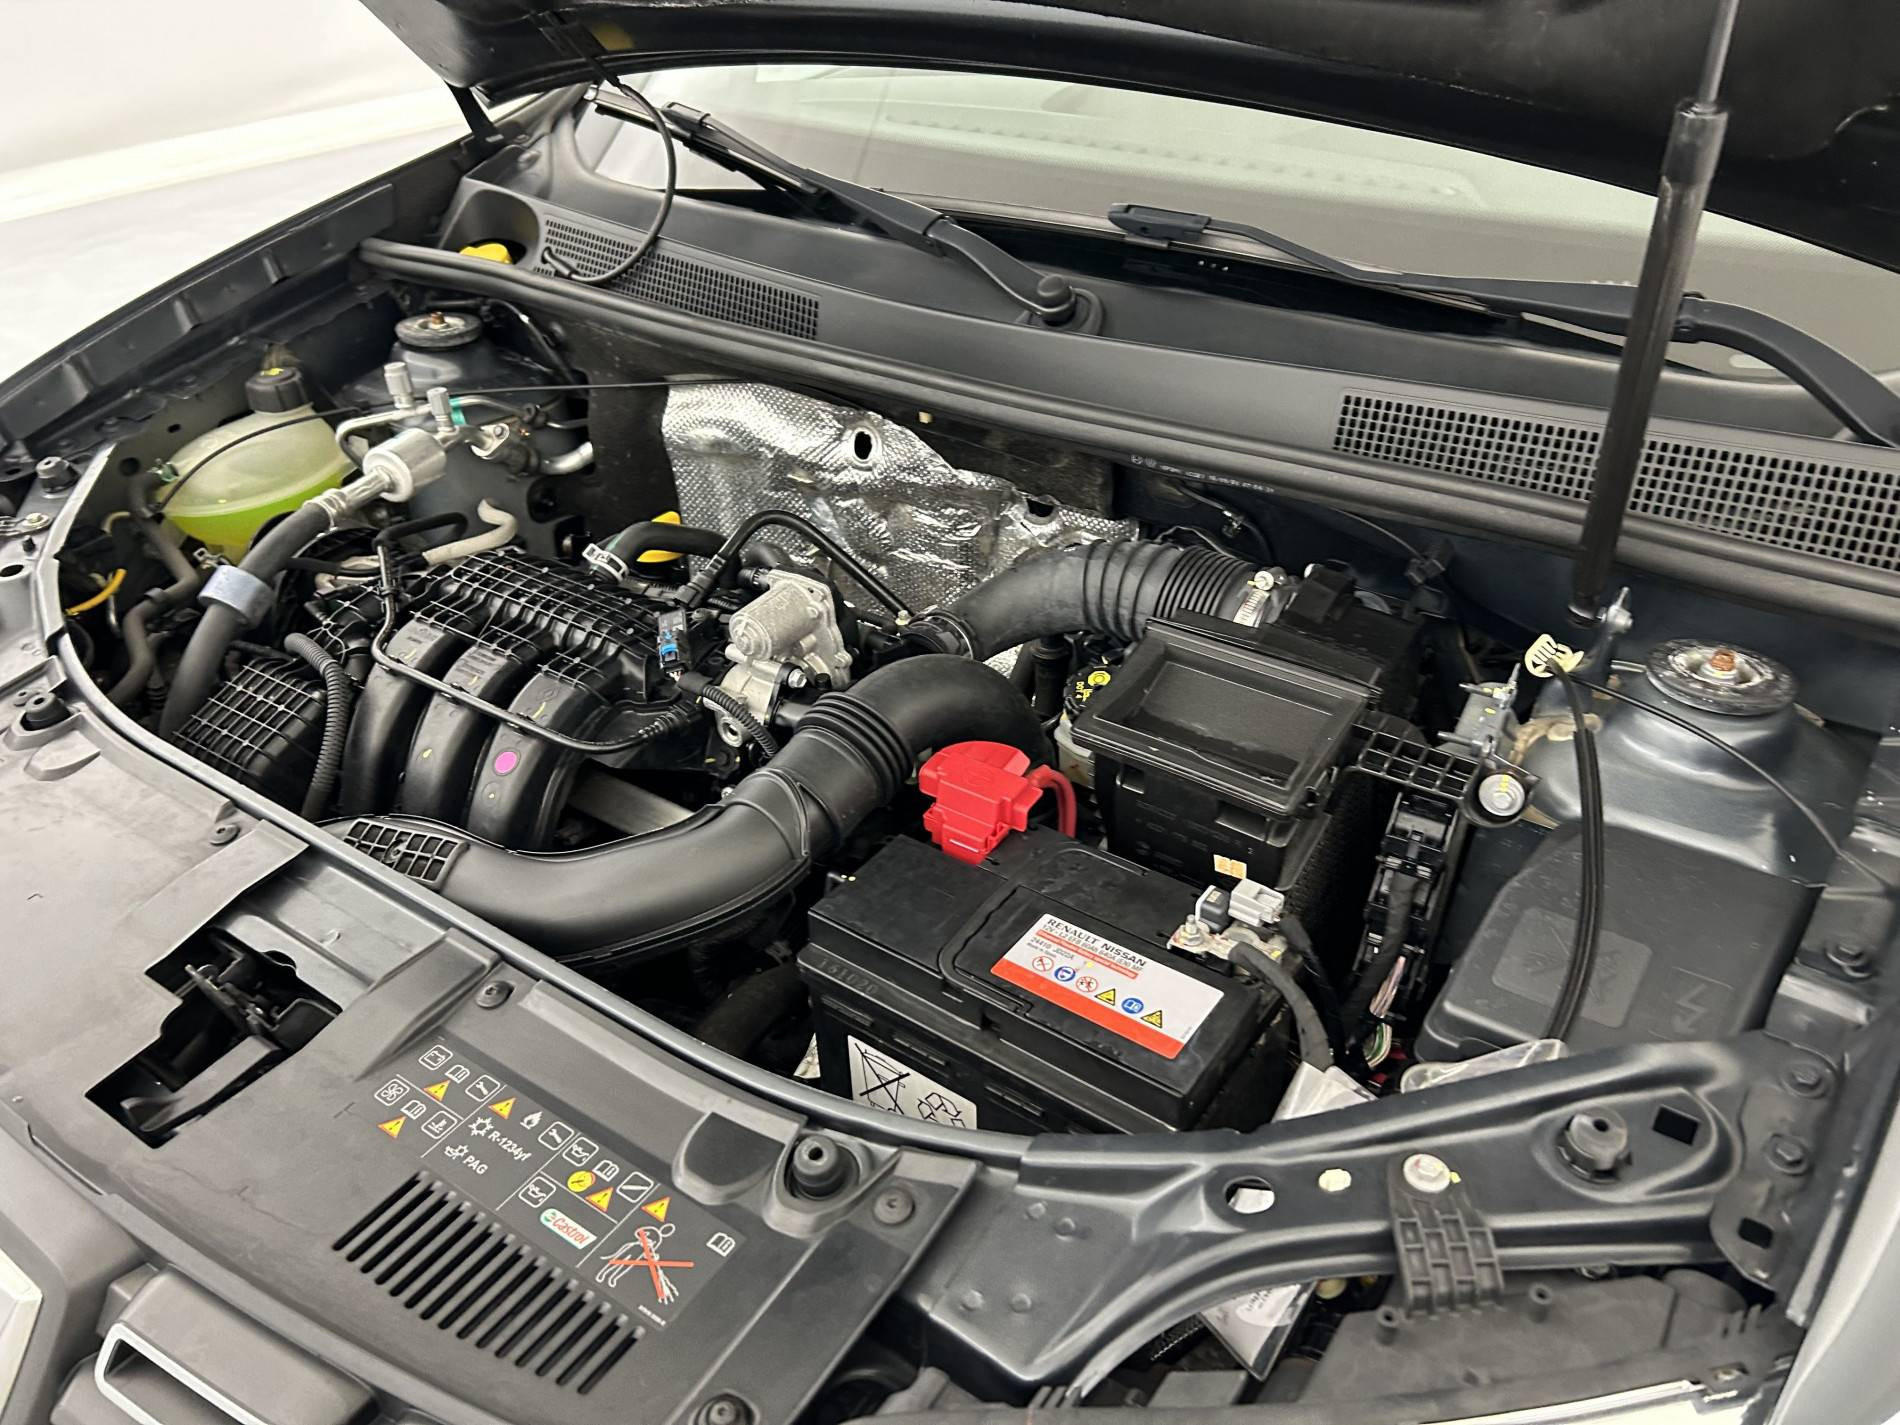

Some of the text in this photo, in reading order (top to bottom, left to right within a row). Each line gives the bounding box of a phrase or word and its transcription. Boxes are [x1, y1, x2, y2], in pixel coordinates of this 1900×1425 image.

[1046, 918, 1147, 967] RENAULT NISSAN
[488, 1130, 532, 1161] R-1234yf
[463, 1155, 488, 1175] PAG
[552, 1215, 590, 1244] Castrol
